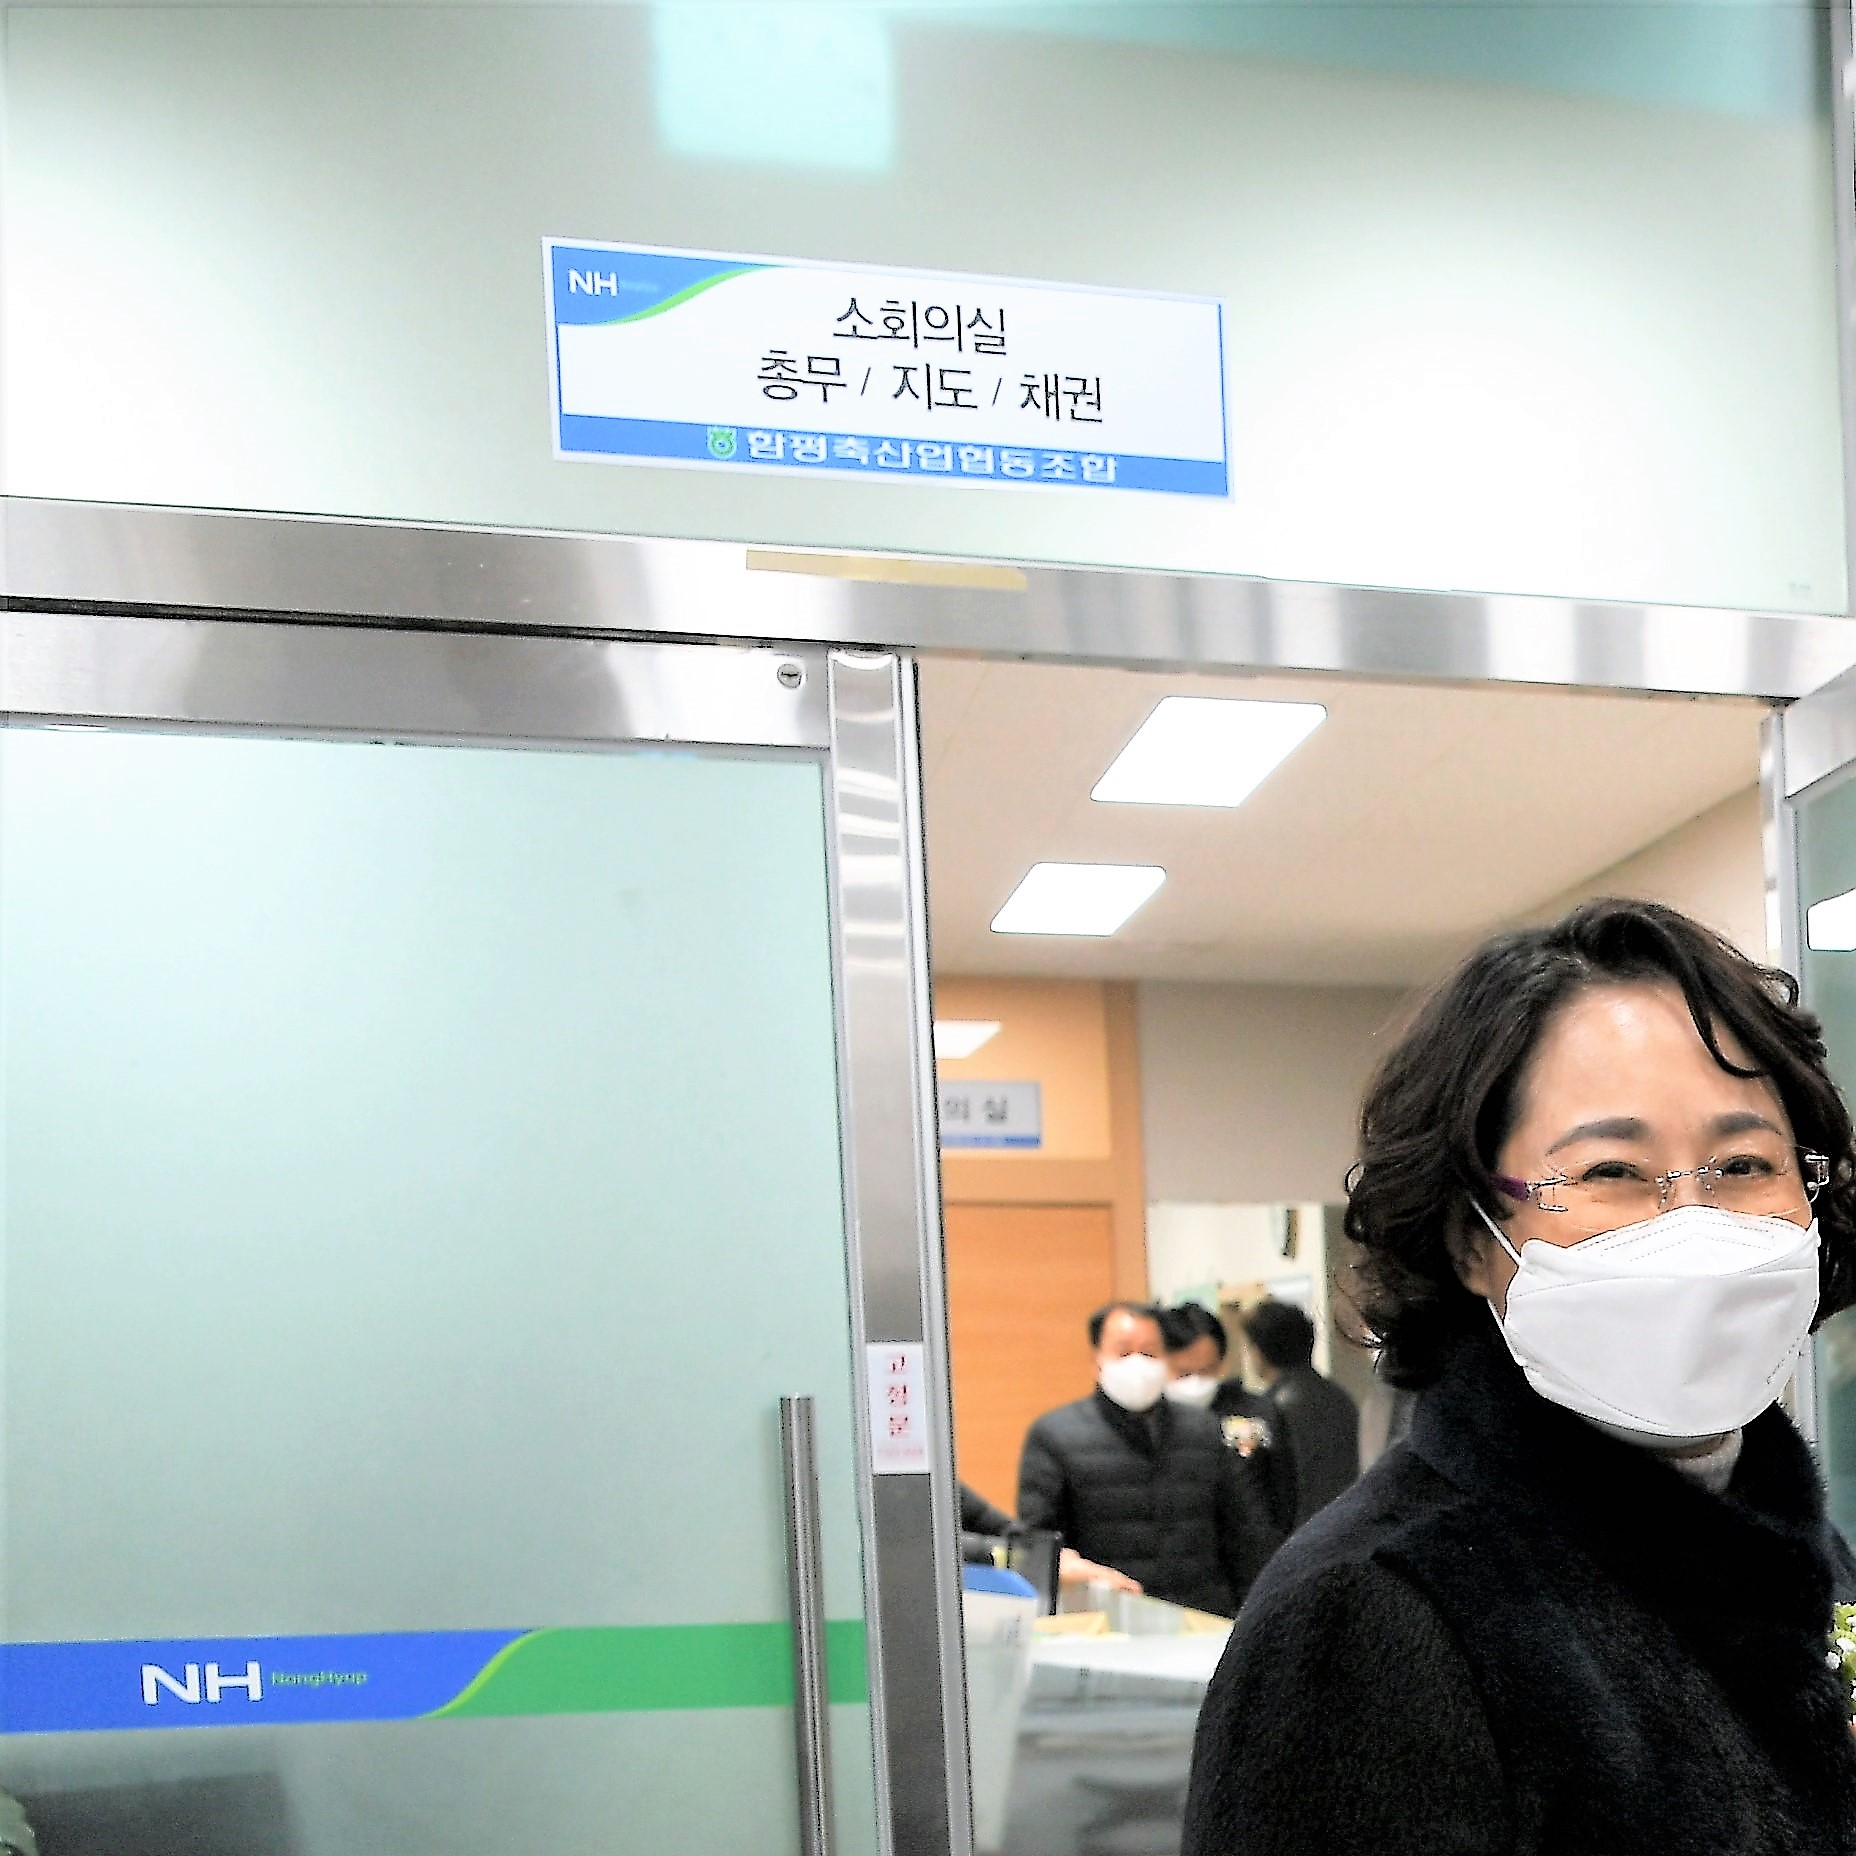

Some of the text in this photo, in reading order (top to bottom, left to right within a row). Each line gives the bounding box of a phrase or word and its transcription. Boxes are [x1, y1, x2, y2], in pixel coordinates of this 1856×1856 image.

[568, 267, 619, 297] NH
[833, 297, 1007, 356] 소회의실
[756, 350, 848, 405] 총무
[892, 363, 981, 411] 지도
[1020, 374, 1104, 424] 채권
[746, 429, 1118, 485] 함평축산업협동조합
[140, 1659, 264, 1706] NH
